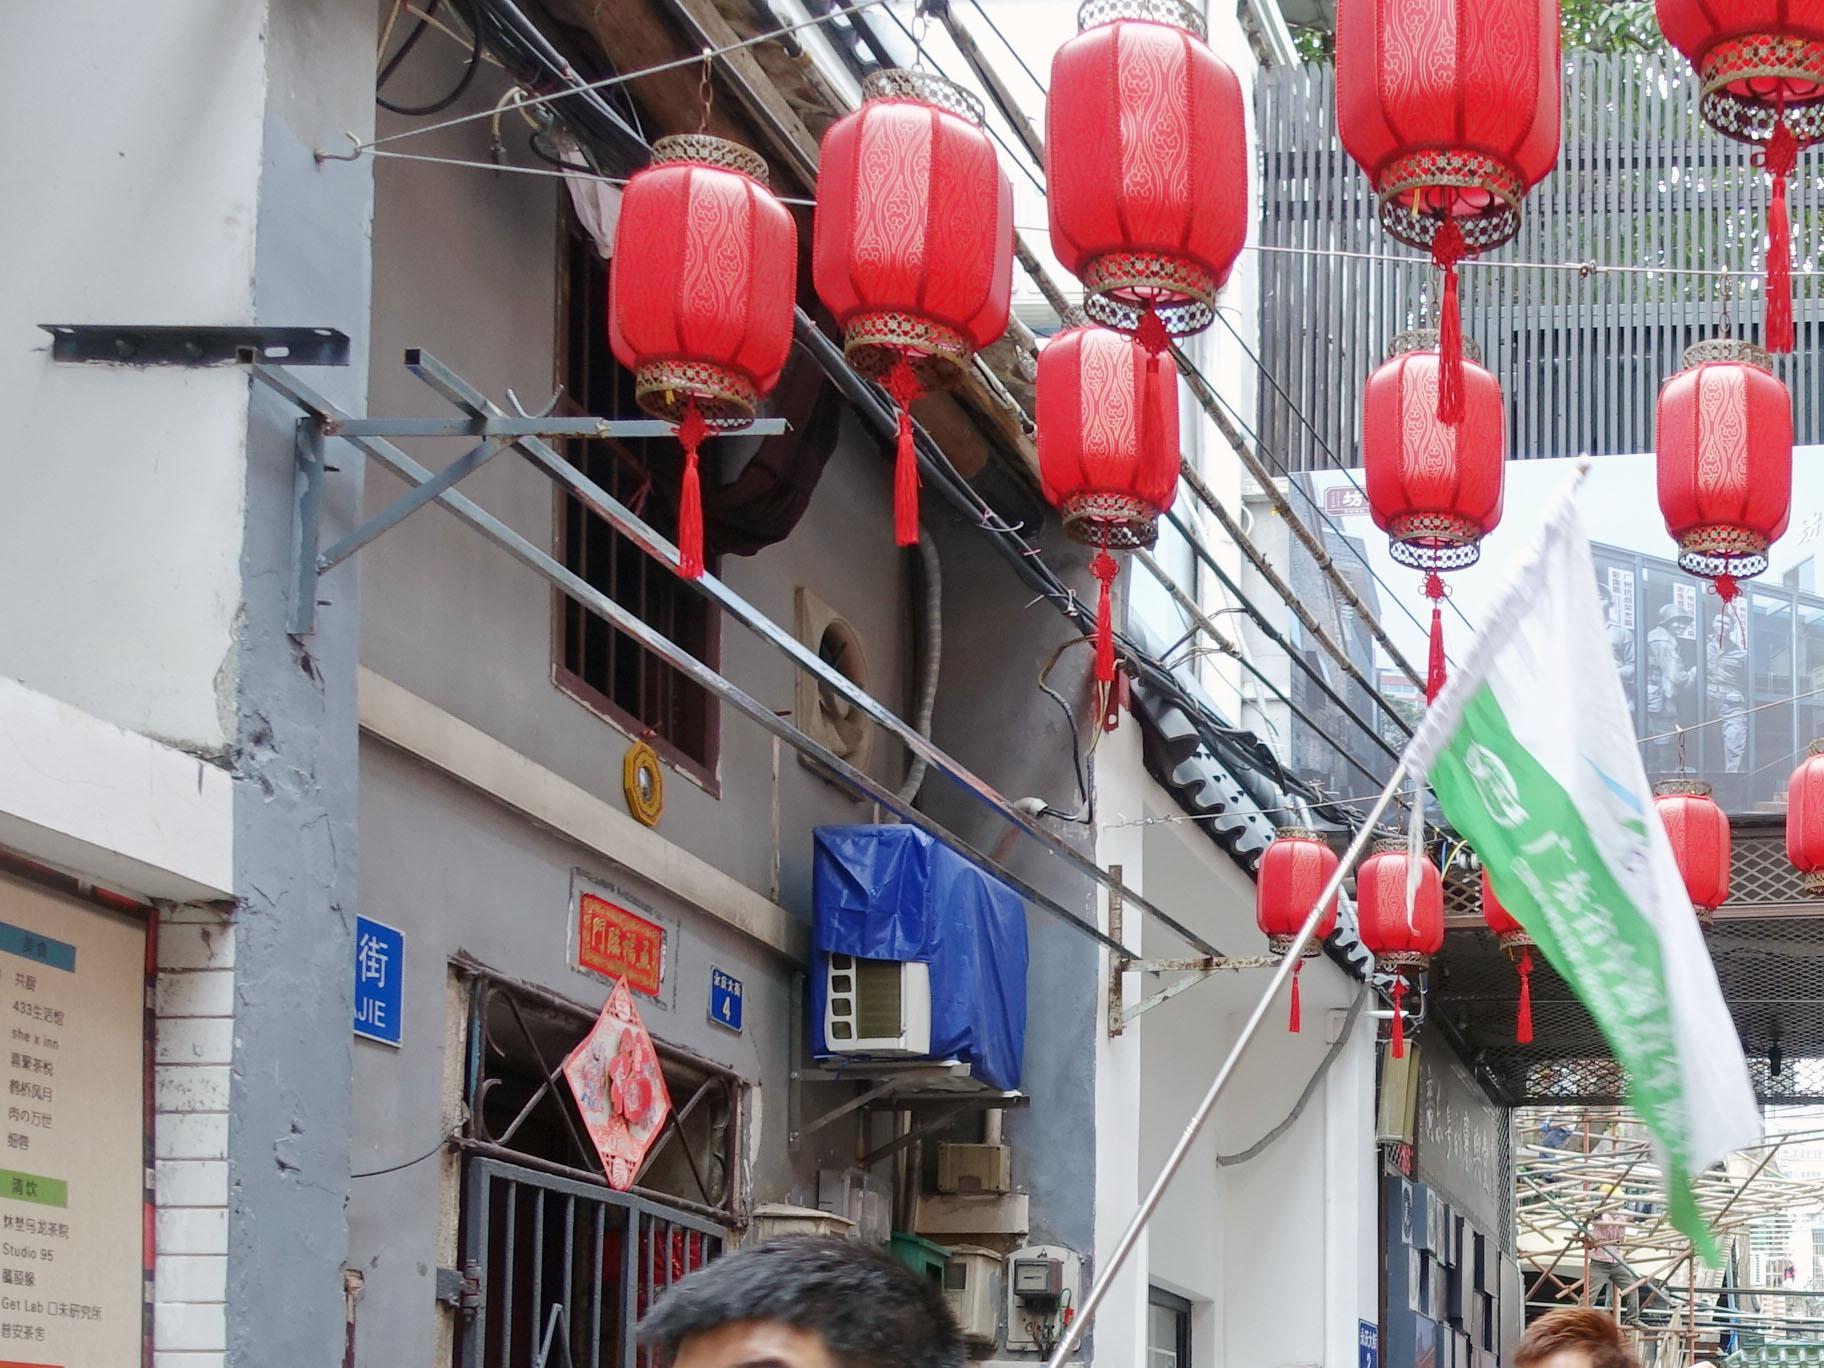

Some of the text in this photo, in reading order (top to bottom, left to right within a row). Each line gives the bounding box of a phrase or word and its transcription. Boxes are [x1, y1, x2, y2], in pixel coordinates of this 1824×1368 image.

[359, 933, 388, 988] 街
[354, 997, 386, 1028] JIE
[722, 996, 731, 1021] 4
[12, 1027, 30, 1043] she
[3, 1242, 54, 1262] Studio 95
[24, 1299, 44, 1314] Lab
